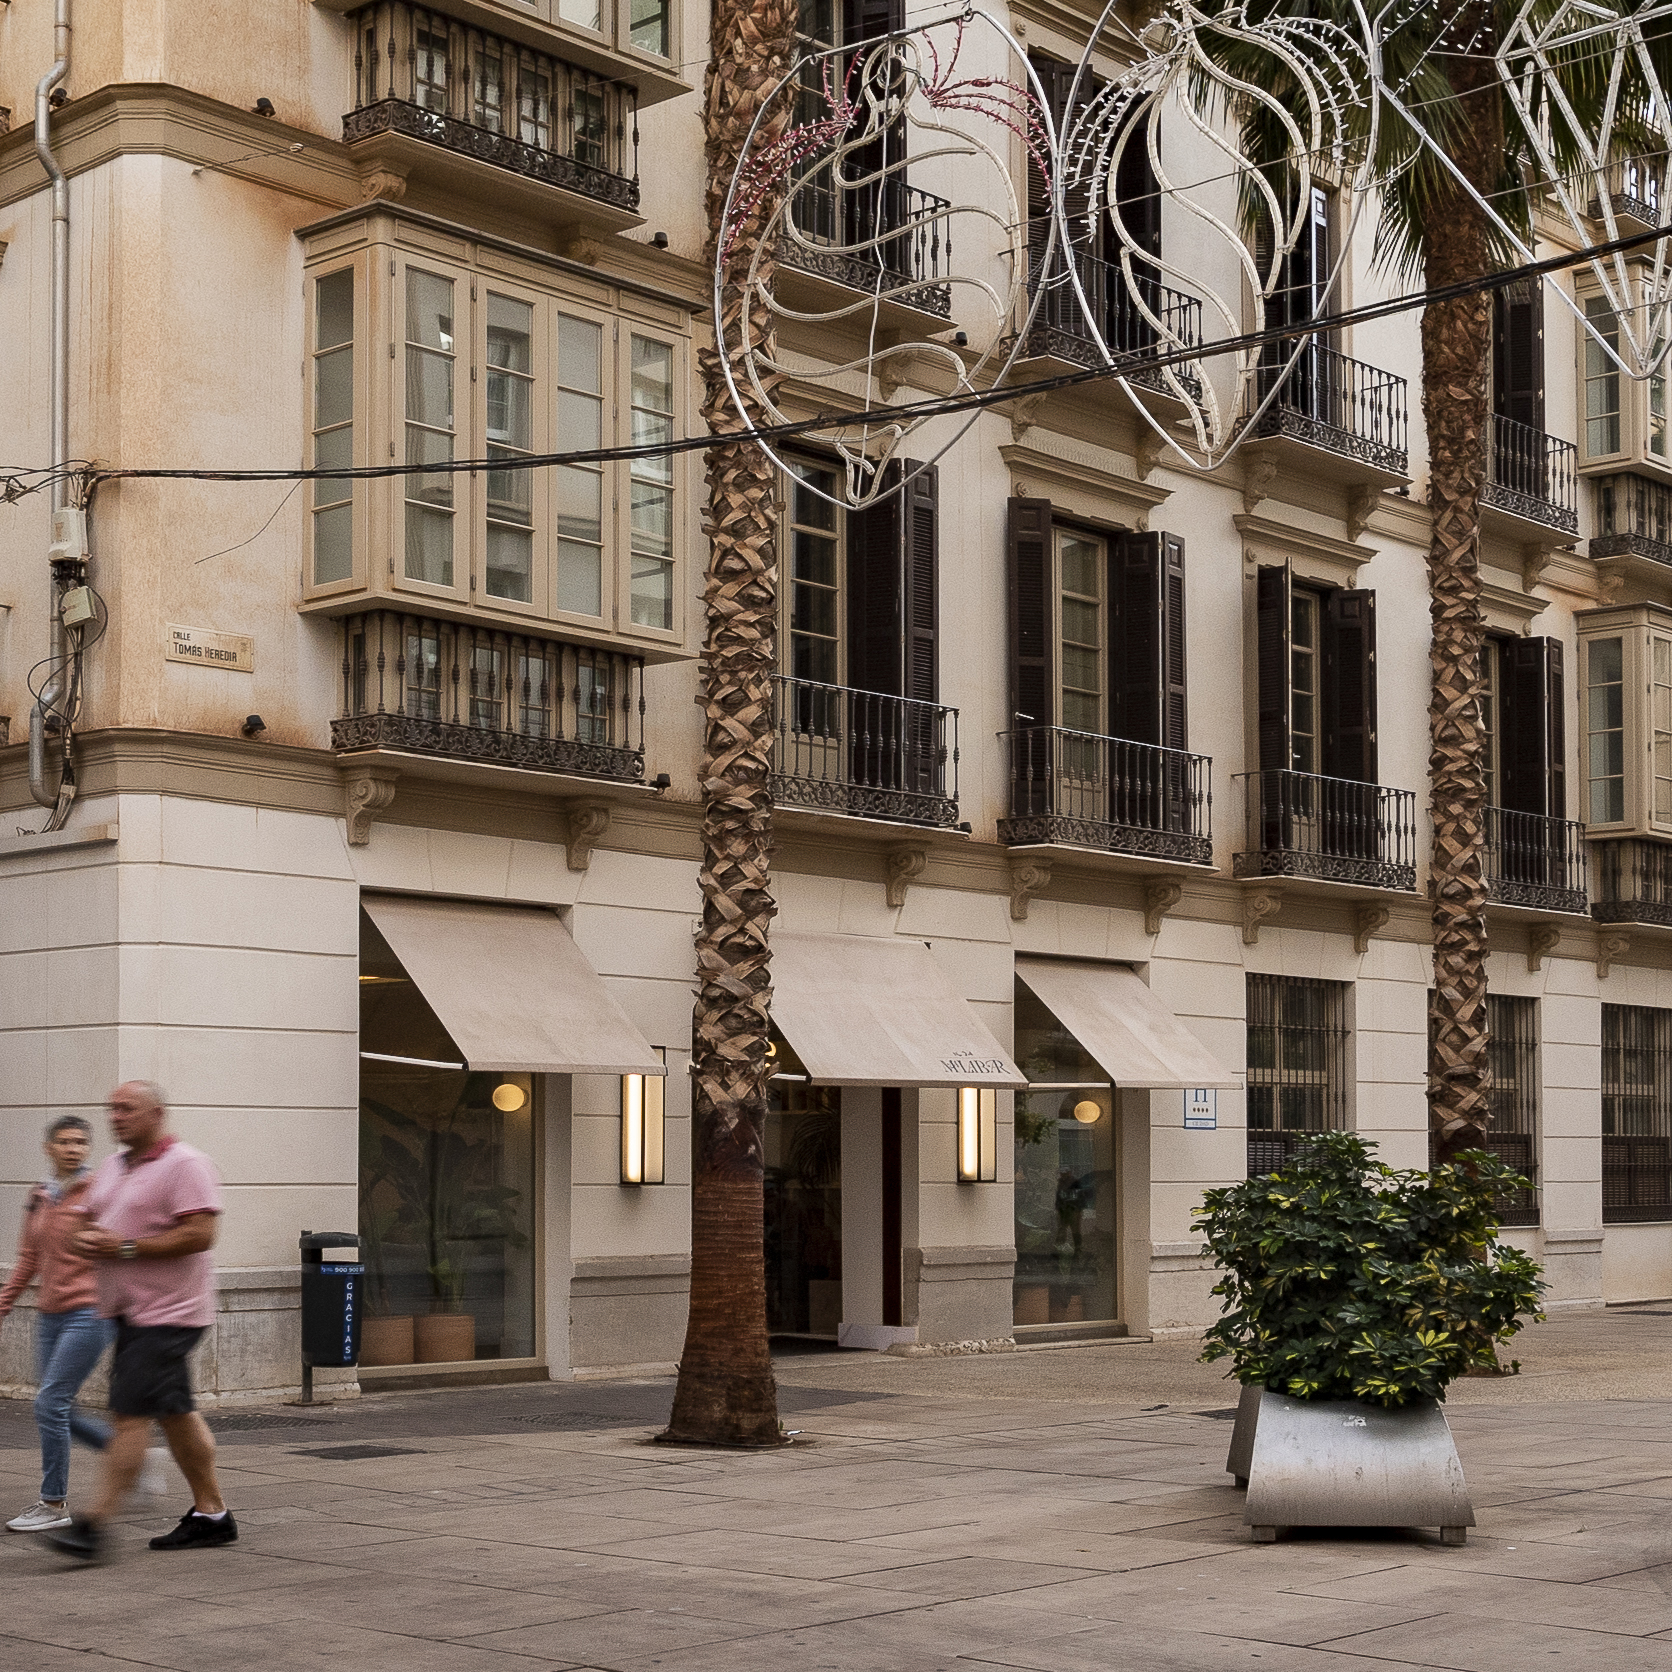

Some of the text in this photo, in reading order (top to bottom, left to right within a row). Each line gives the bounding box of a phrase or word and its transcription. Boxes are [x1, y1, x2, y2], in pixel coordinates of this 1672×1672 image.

[173, 631, 191, 641] CALLE
[173, 641, 237, 662] TOMÁS HEREDIA
[344, 1282, 353, 1354] GRACIAS
